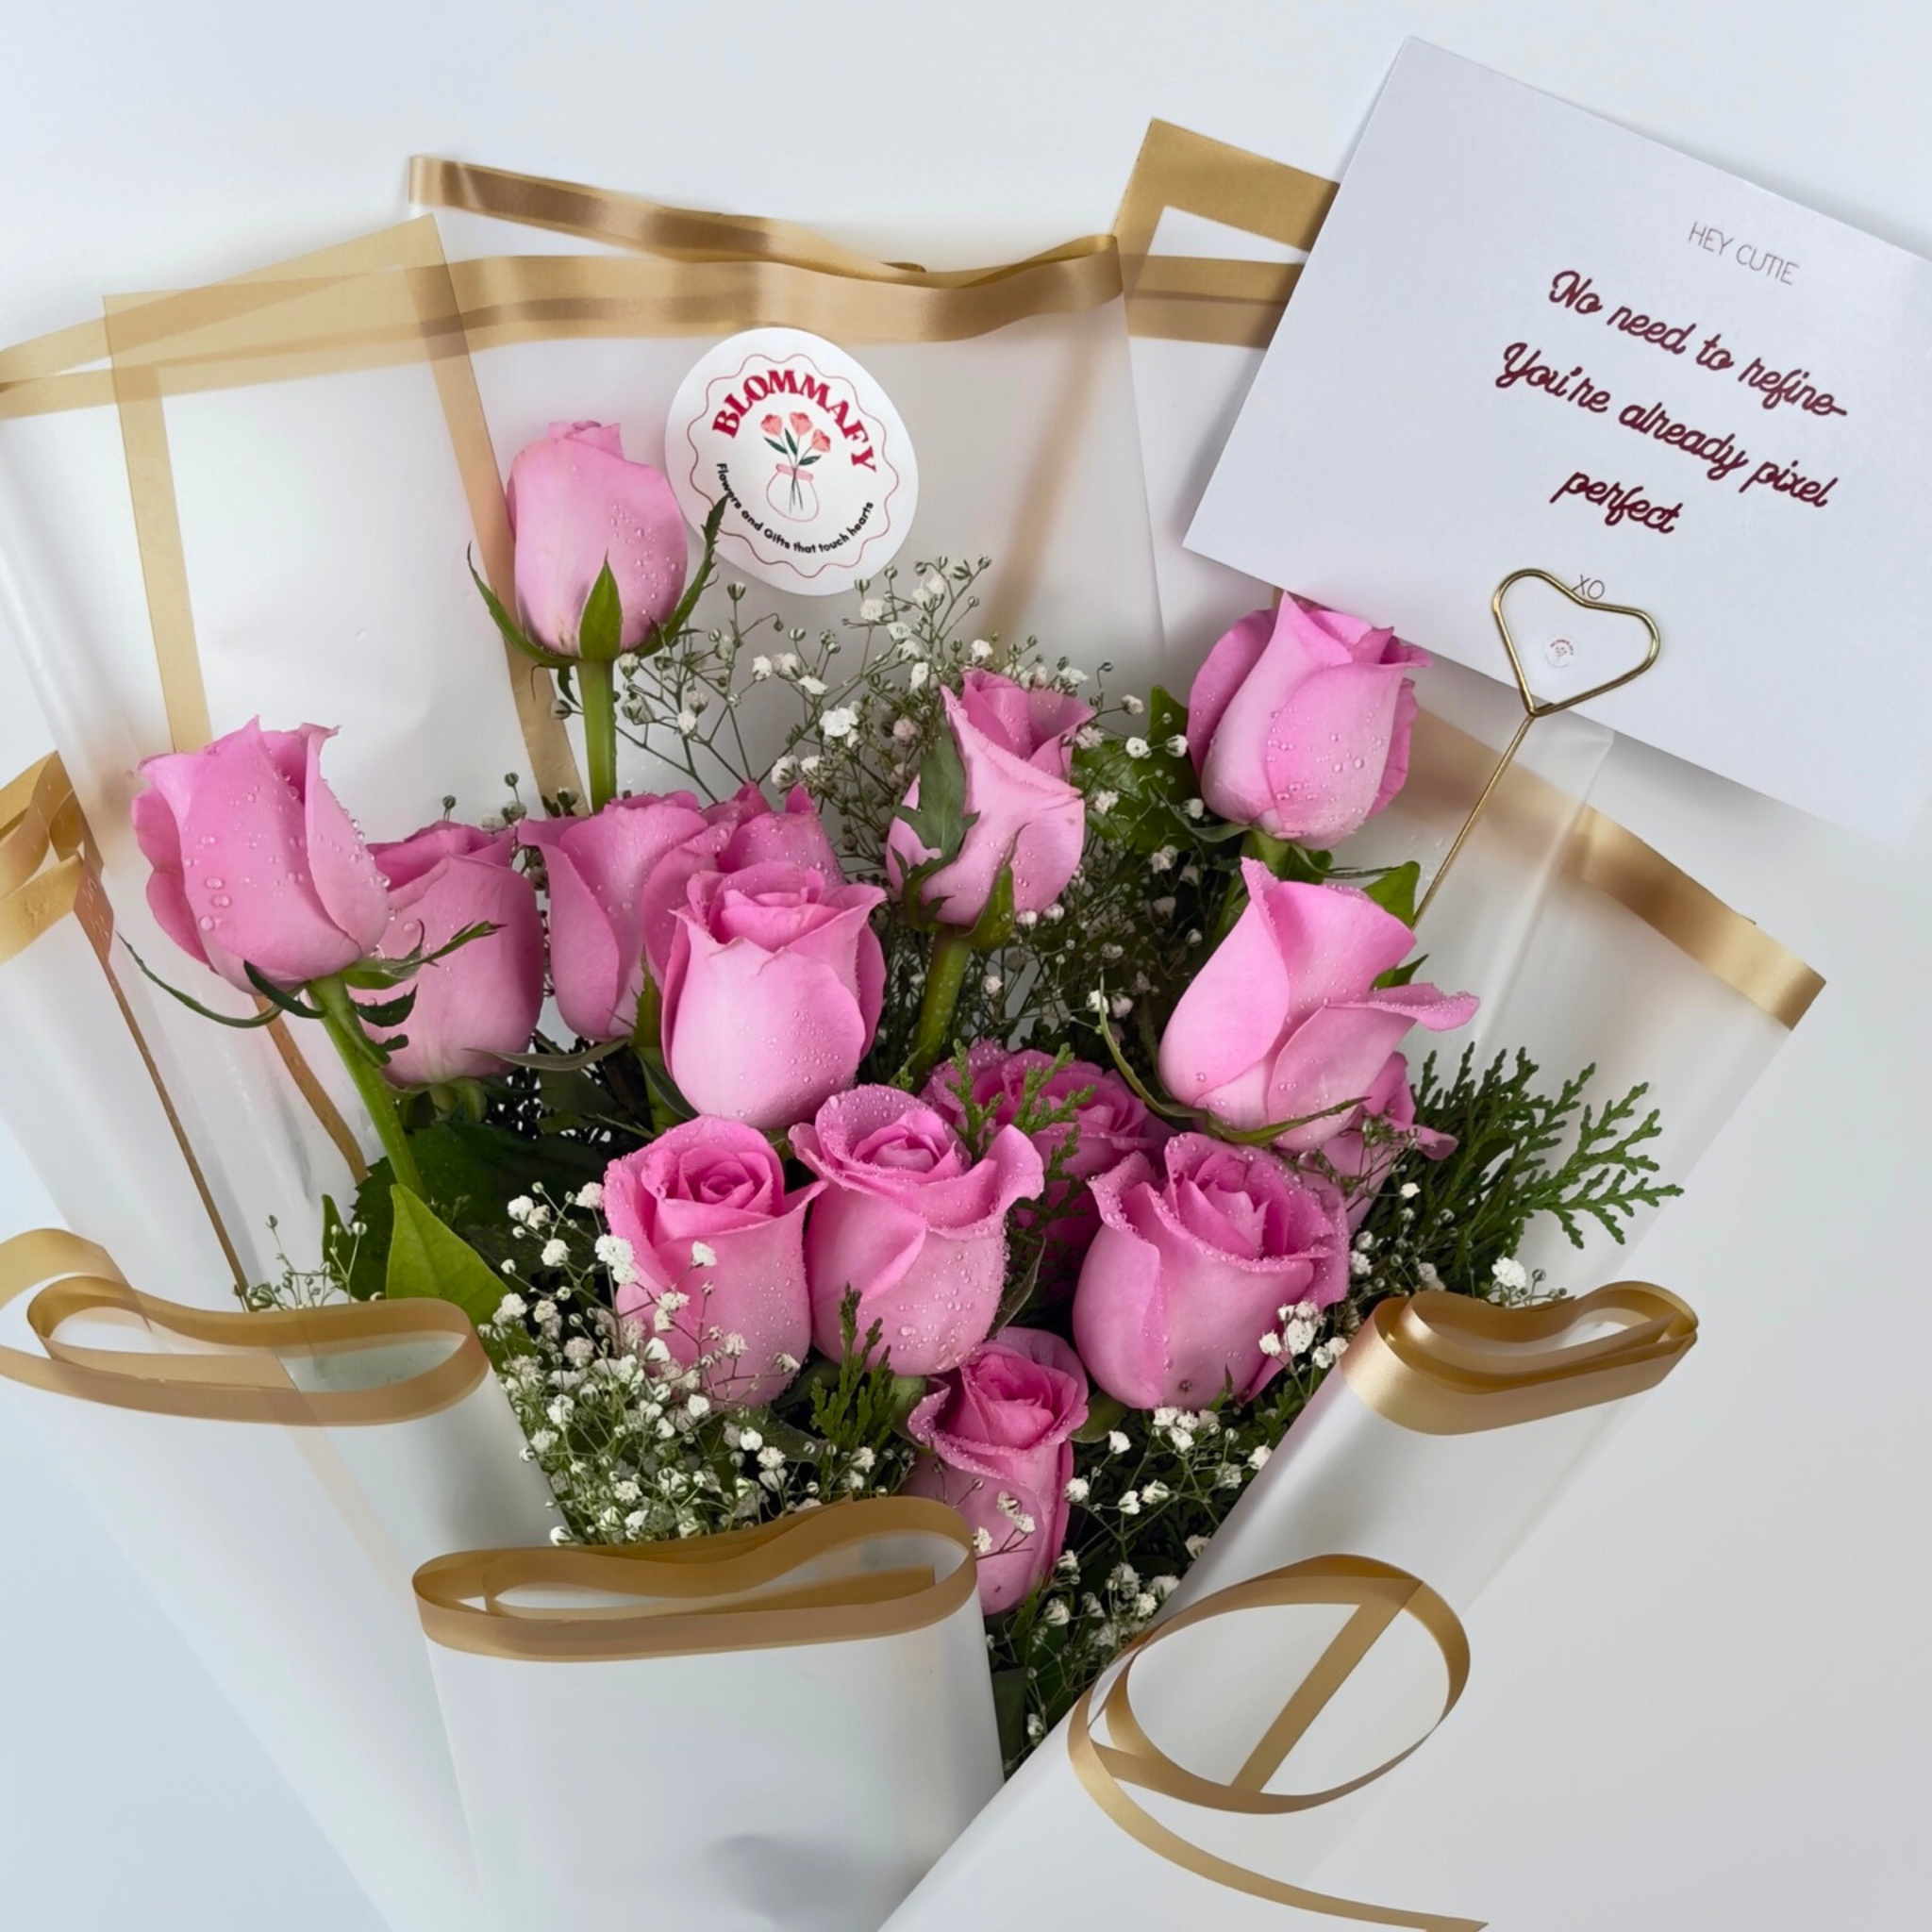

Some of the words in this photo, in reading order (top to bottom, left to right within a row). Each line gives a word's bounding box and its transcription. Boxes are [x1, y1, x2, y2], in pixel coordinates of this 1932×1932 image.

[1688, 221, 1735, 257] HEY
[1735, 243, 1801, 286] CUTIE
[1548, 270, 1604, 315] No
[1606, 305, 1697, 356] need
[1695, 333, 1735, 372] to
[711, 369, 877, 473] BLOMMAFY
[1494, 341, 1611, 414] You're
[1618, 401, 1750, 481] already
[1738, 459, 1839, 508] pixel
[716, 462, 742, 509] Flowers
[741, 509, 764, 532] and
[763, 527, 791, 550] Gifts
[792, 541, 817, 555] that
[817, 532, 851, 553] touch
[845, 501, 874, 537] hearts
[1548, 471, 1684, 535] perfect
[1572, 574, 1606, 600] XO
